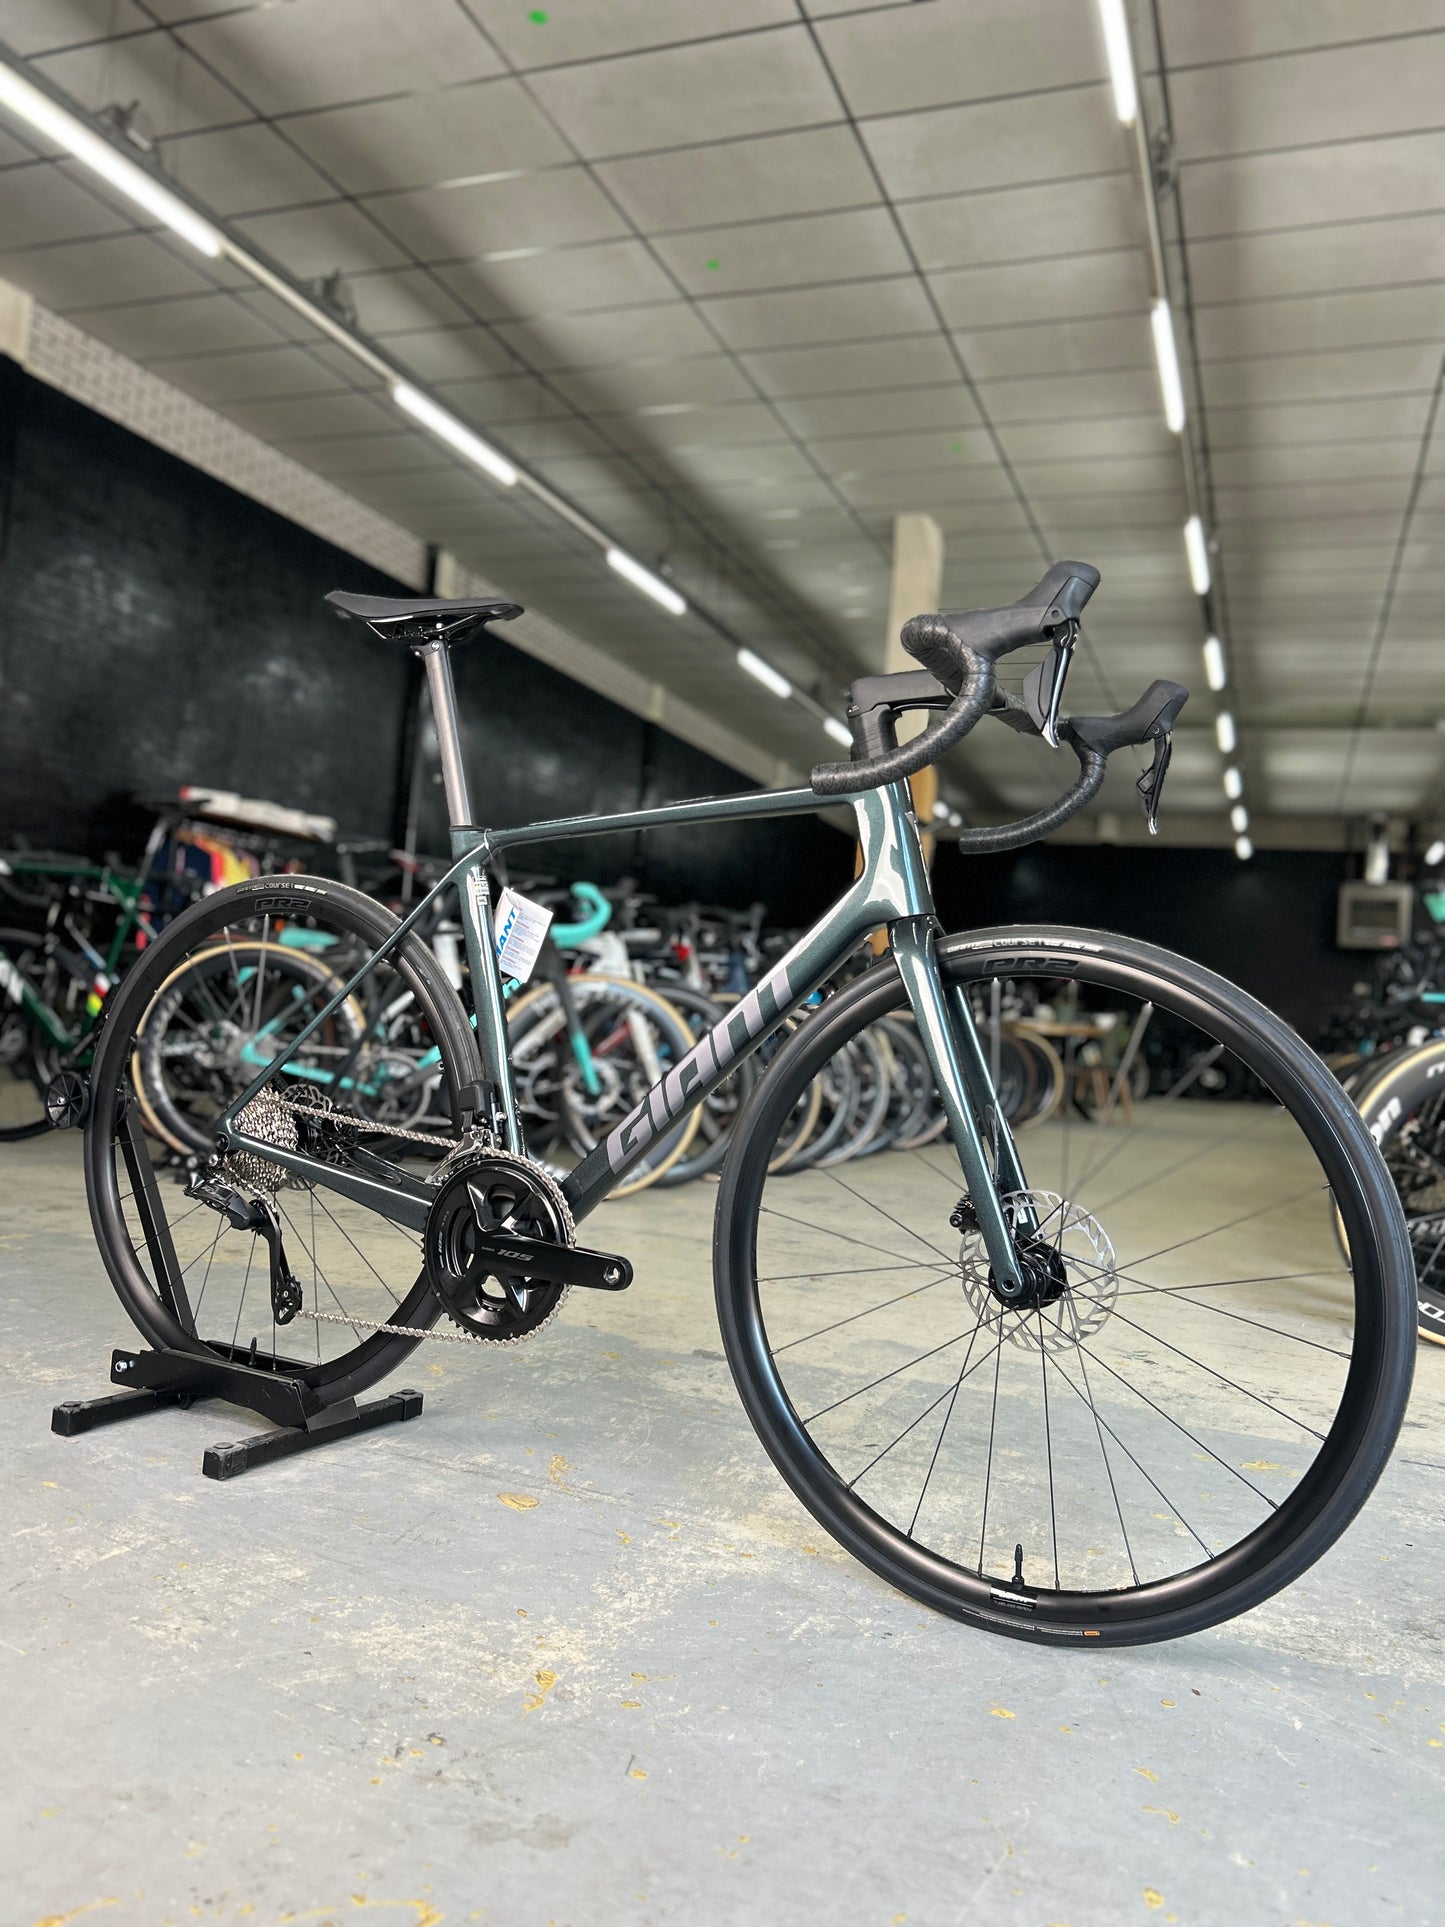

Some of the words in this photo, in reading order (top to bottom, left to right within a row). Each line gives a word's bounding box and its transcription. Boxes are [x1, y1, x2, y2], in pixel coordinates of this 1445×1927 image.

[255, 897, 312, 911] PR2
[496, 906, 516, 956] IANT
[981, 957, 1081, 974] PR2
[607, 941, 800, 1176] GIANT
[497, 1248, 534, 1261] 105
